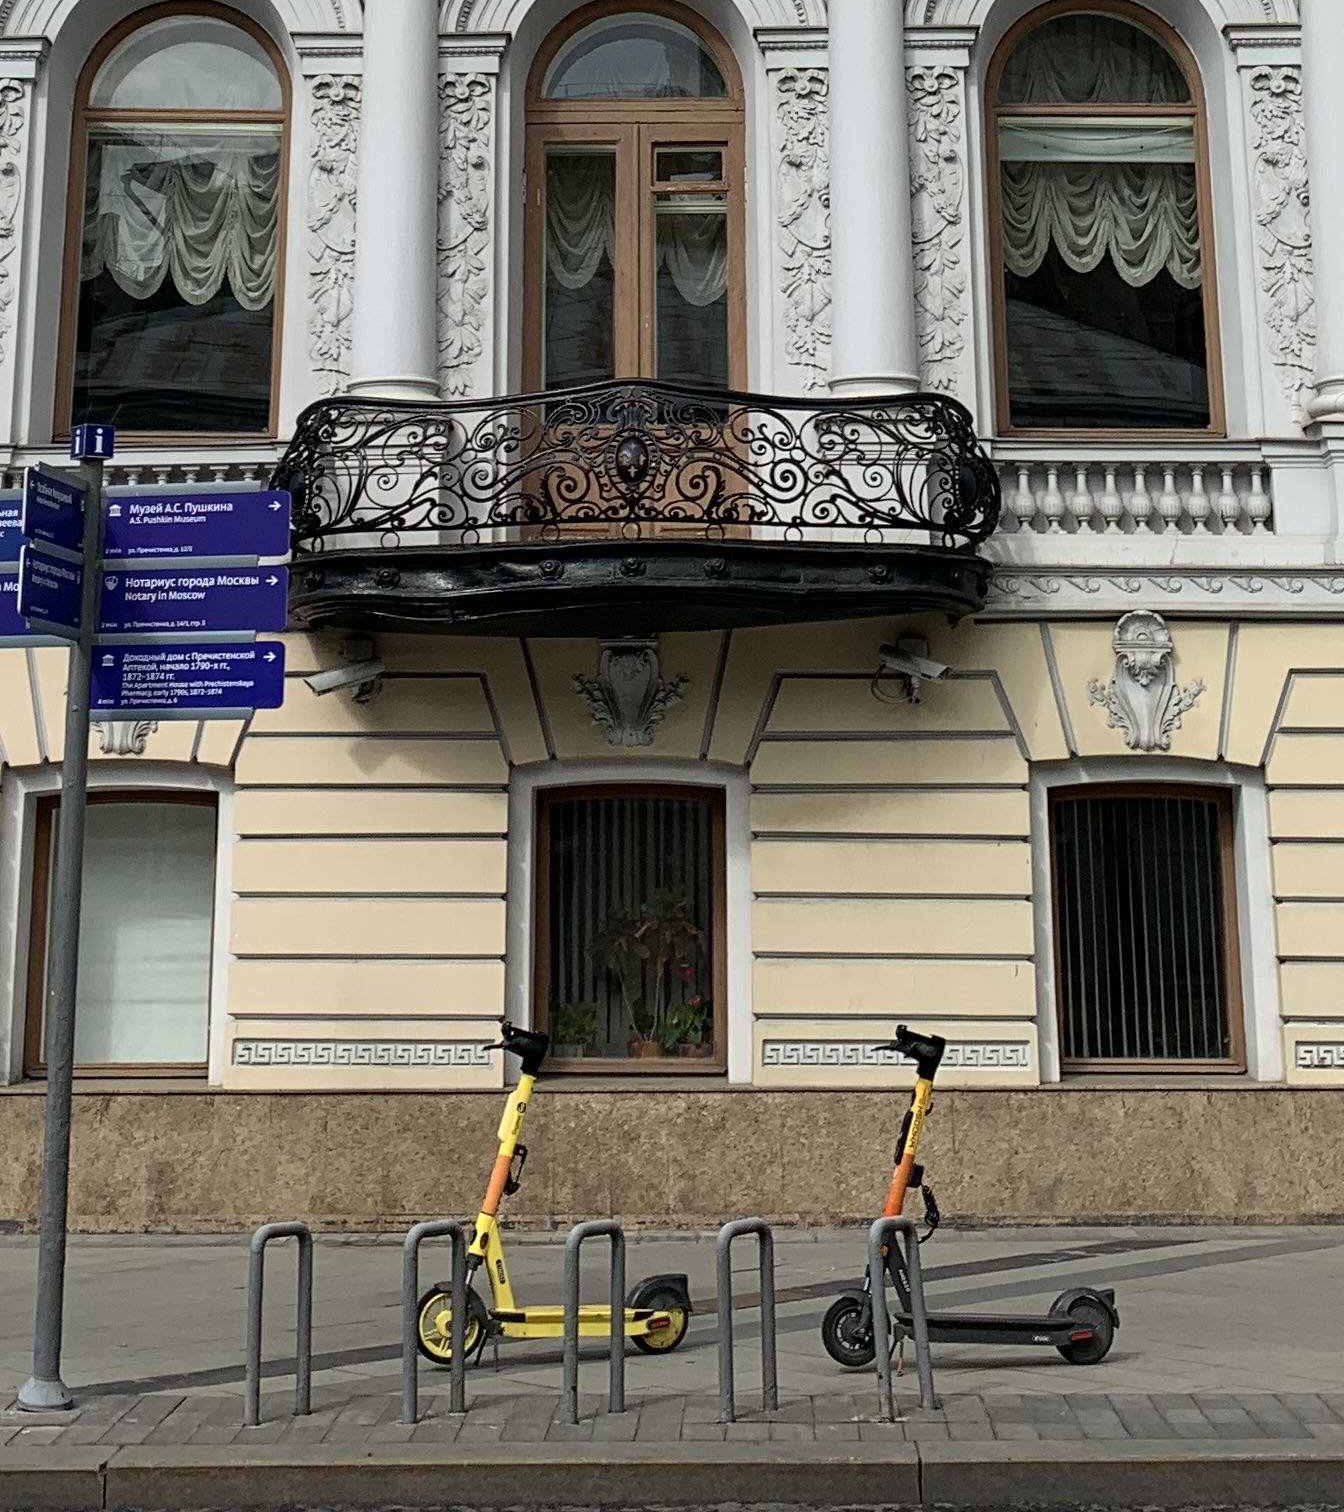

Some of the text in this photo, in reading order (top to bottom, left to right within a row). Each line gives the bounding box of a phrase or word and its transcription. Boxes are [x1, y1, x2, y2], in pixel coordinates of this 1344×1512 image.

[130, 502, 233, 516] Музей А.С. Пушкина
[144, 516, 173, 524] Pushkin
[174, 515, 206, 523] Museum
[126, 575, 259, 589] Нотариус города Москвы
[125, 591, 206, 603] Notary in Moscow
[122, 653, 166, 663] Доходный
[167, 654, 184, 662] дом
[192, 651, 255, 661] Пречистенской
